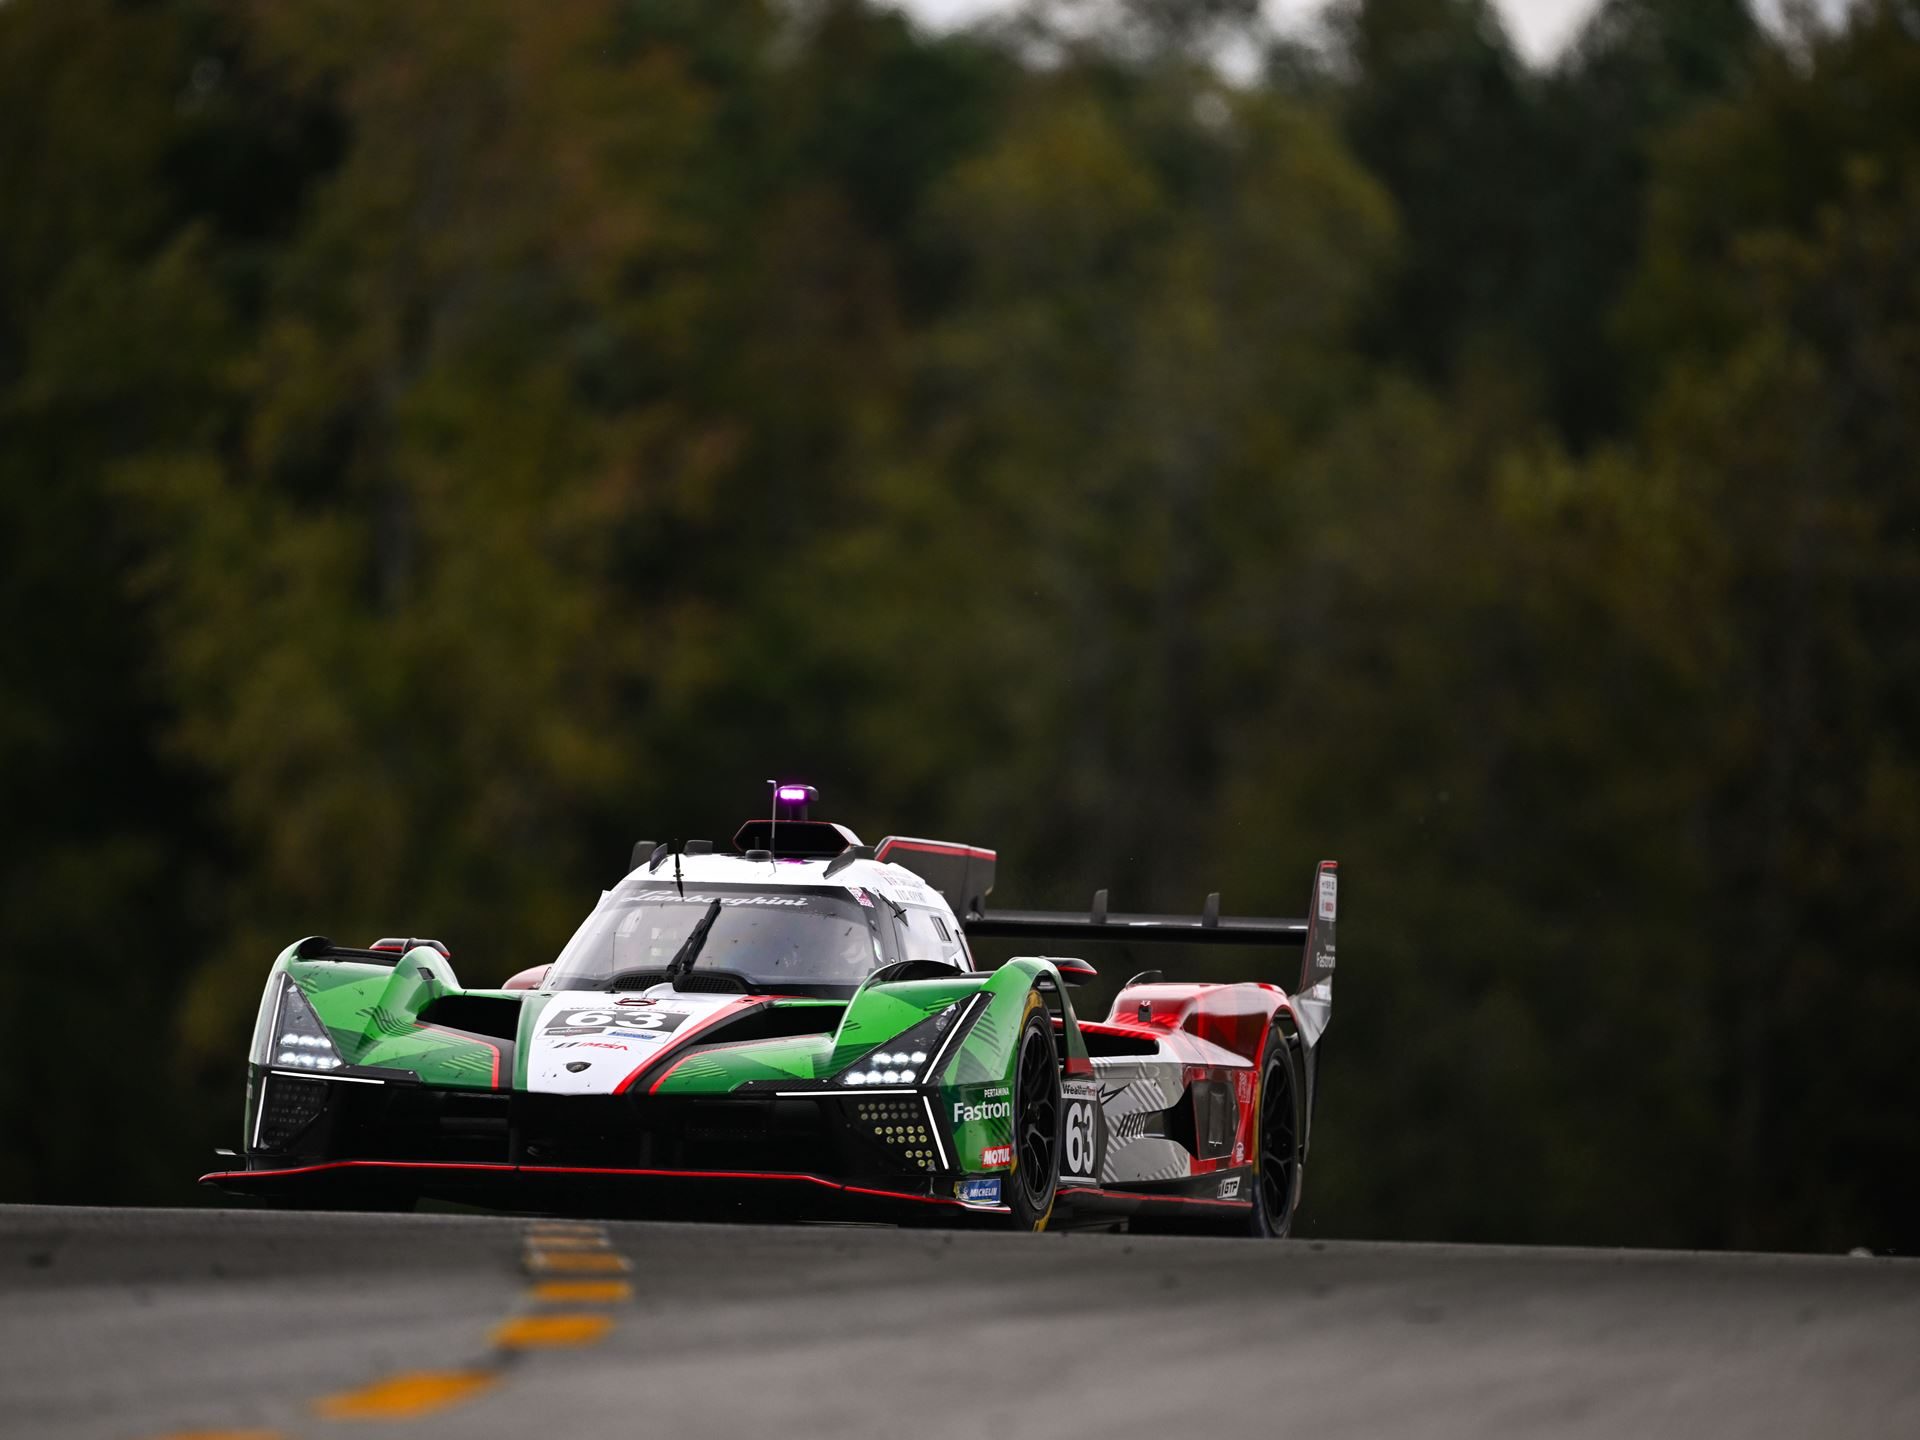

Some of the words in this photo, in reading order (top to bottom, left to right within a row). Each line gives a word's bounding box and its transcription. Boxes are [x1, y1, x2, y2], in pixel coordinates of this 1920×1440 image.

[1316, 952, 1336, 969] Fastron
[565, 1010, 667, 1028] 63
[984, 1087, 1009, 1098] PERTAMINA
[953, 1101, 1010, 1123] Fastron
[1066, 1102, 1094, 1174] 63
[983, 1148, 1010, 1165] MOTUL
[969, 1187, 998, 1198] MICHELIN
[1224, 1181, 1238, 1194] GTP
